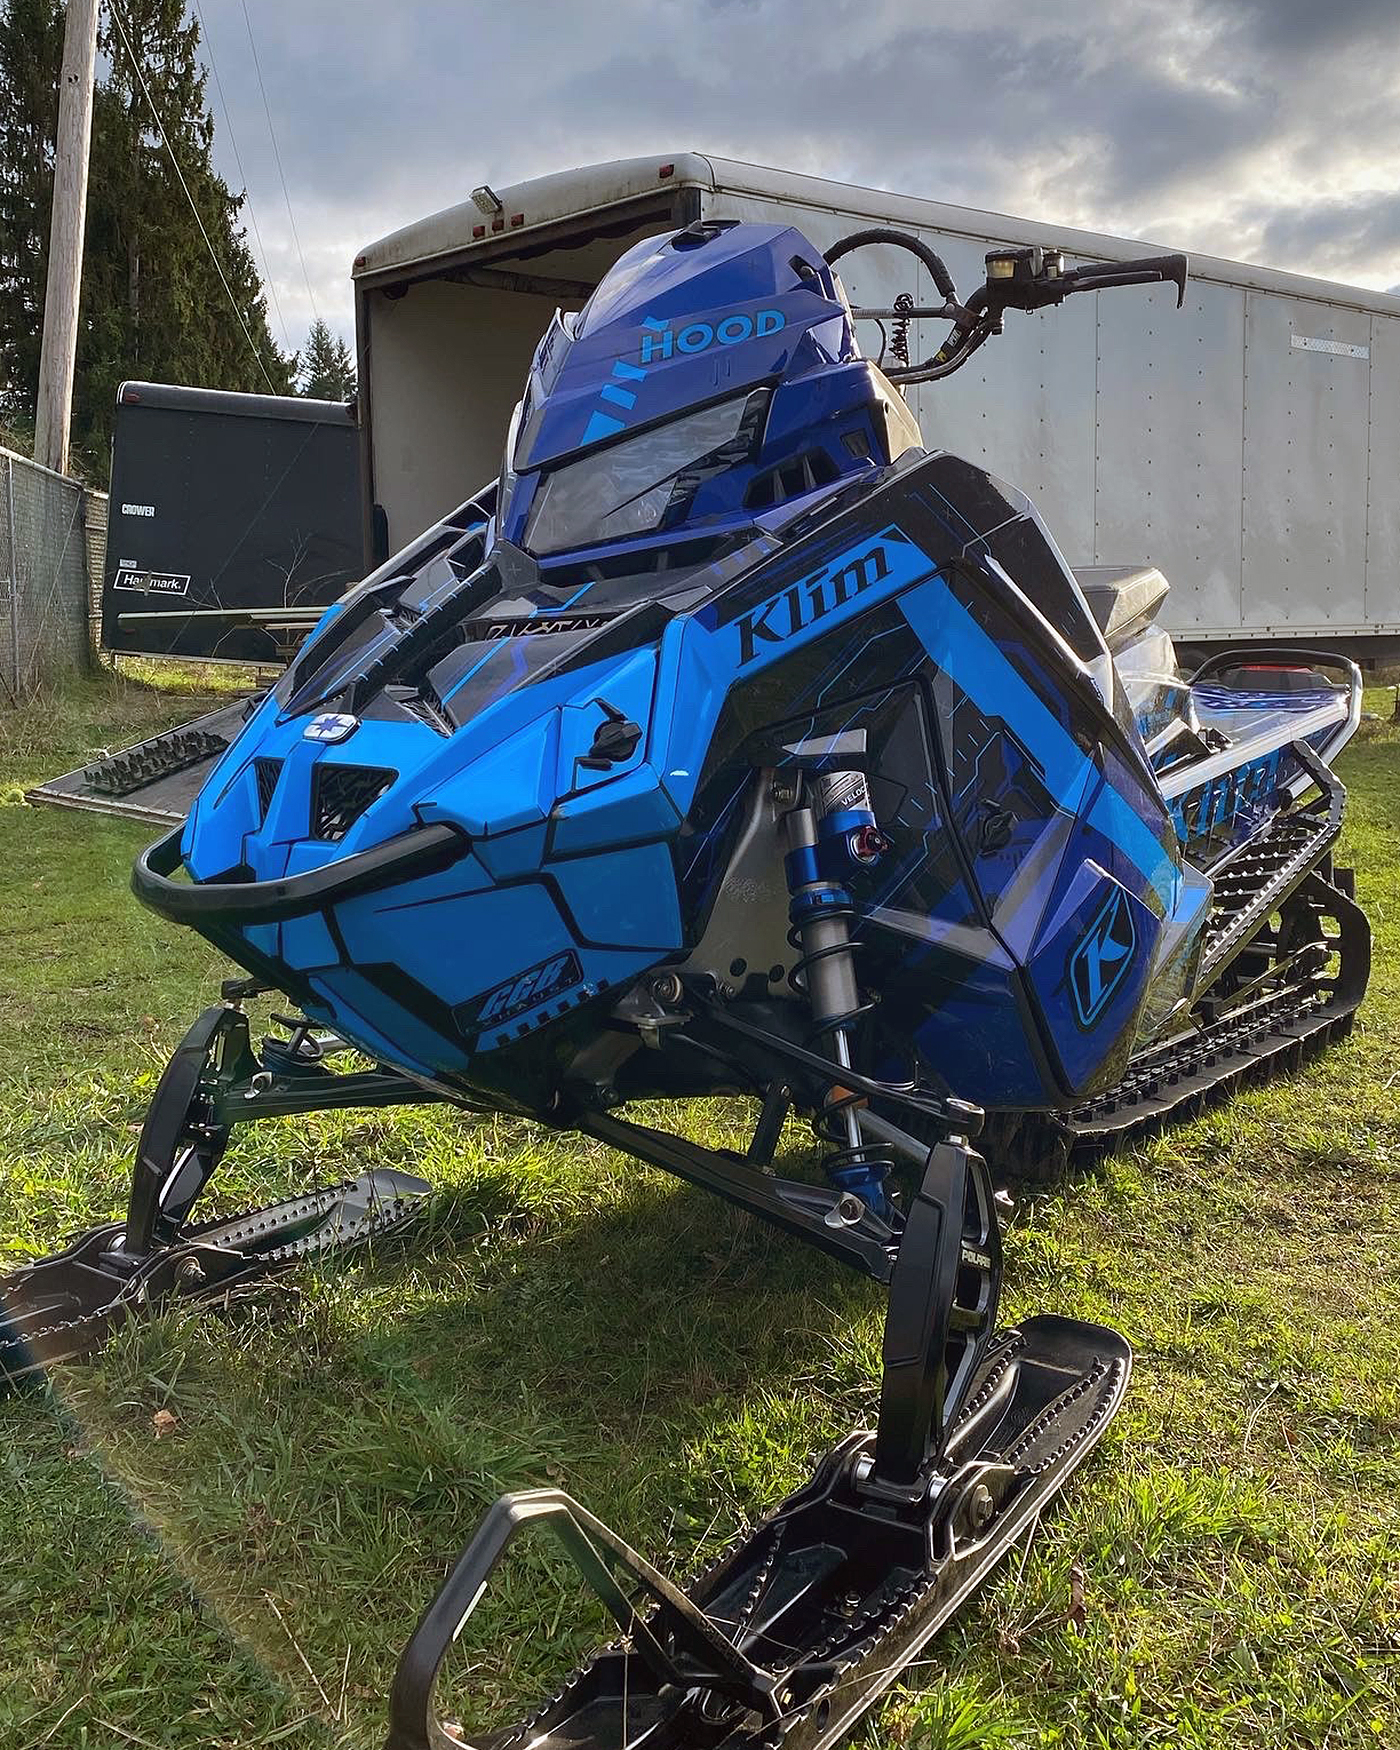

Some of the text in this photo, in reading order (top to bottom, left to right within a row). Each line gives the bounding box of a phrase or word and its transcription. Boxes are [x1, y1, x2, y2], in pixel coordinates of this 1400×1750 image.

[640, 309, 786, 364] HOOD
[121, 503, 155, 517] CROWER
[123, 573, 182, 590] Hamark.
[734, 546, 894, 669] Klim
[961, 1248, 991, 1269] POLARIS
